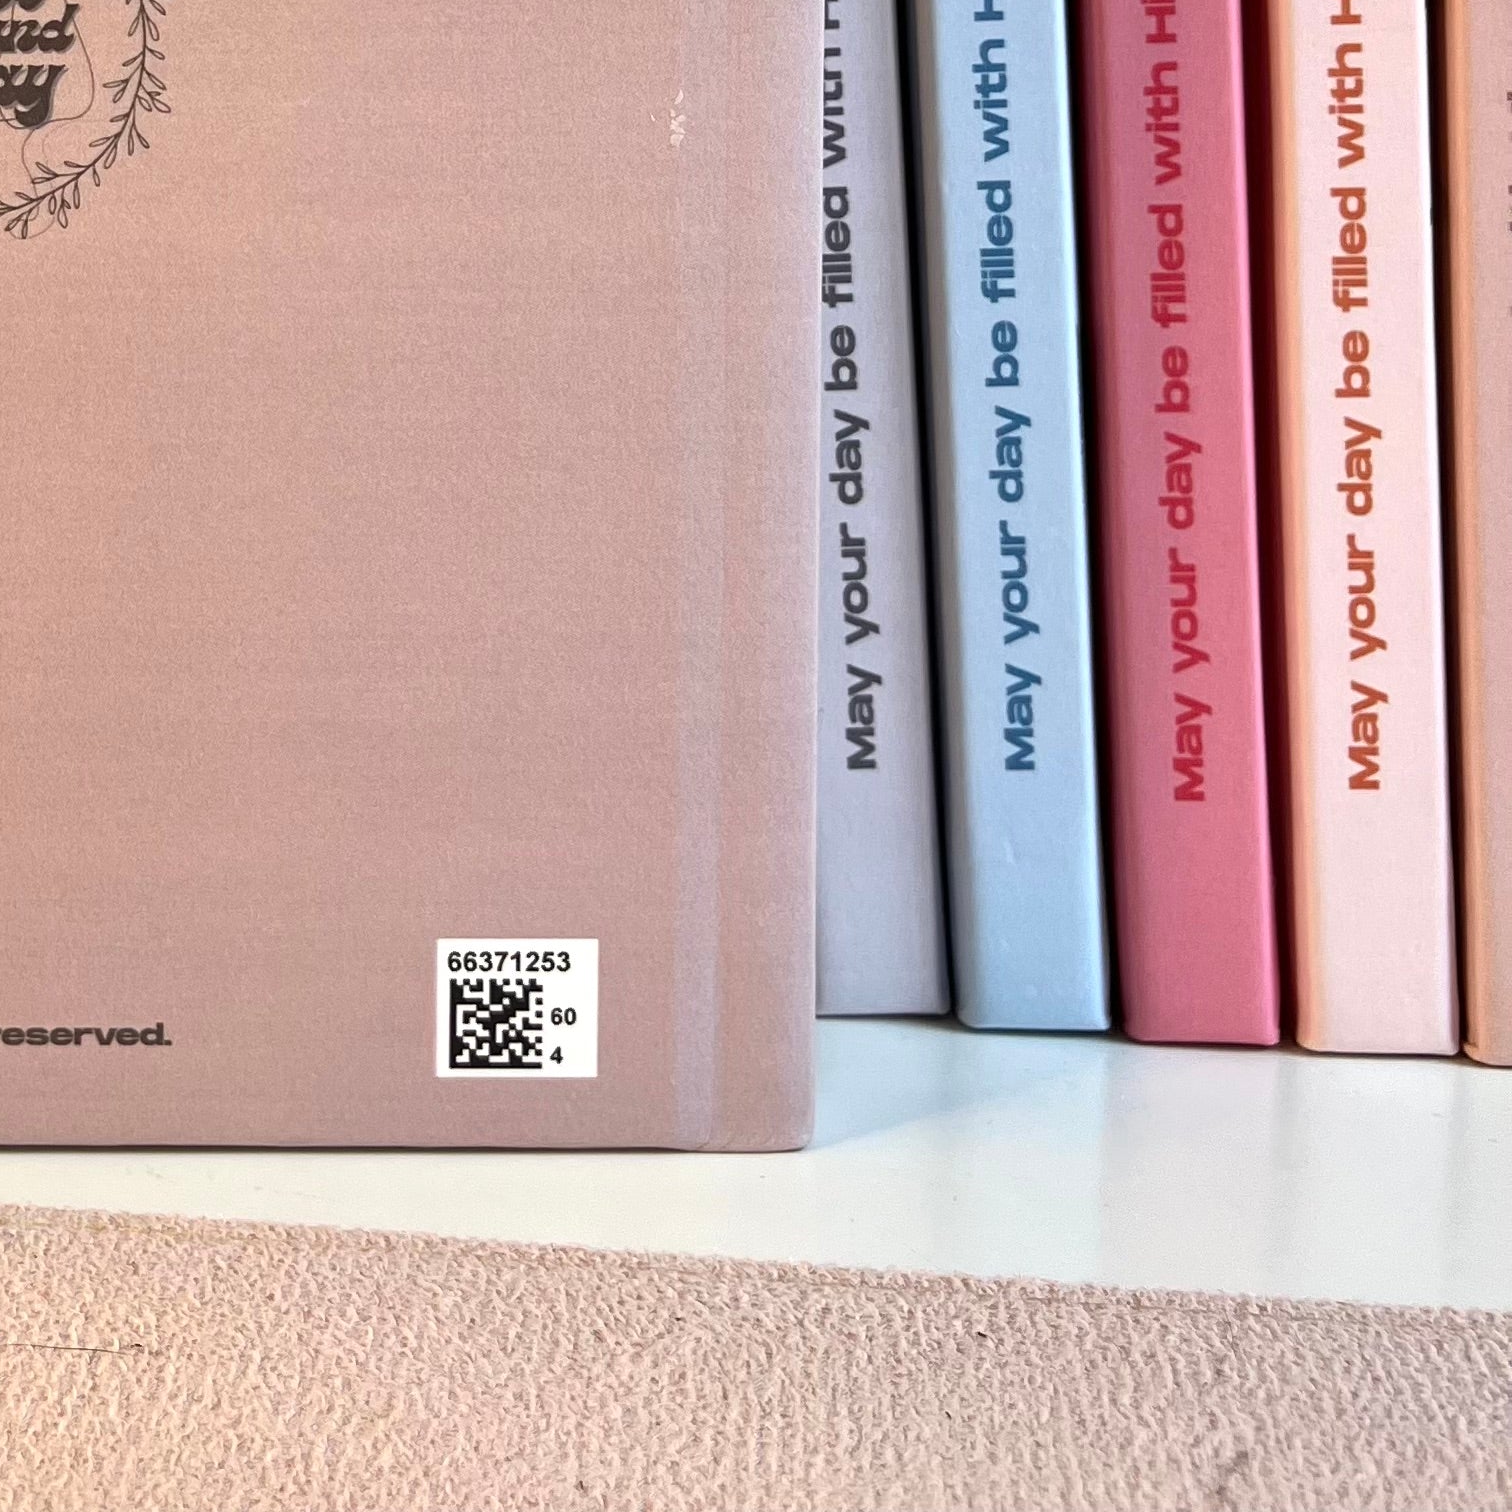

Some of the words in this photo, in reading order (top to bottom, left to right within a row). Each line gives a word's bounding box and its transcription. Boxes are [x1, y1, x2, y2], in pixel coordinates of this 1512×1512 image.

[973, 39, 1009, 162] with
[1144, 62, 1181, 185] with
[1328, 43, 1364, 168] with
[822, 187, 853, 308] filled
[977, 181, 1015, 303] filled
[1148, 204, 1187, 328] filled
[1331, 188, 1368, 312] filled
[825, 326, 858, 391] be
[986, 321, 1019, 387] be
[1155, 347, 1190, 413] be
[1335, 331, 1370, 398] be
[829, 410, 870, 505] day
[989, 406, 1031, 502] day
[1159, 432, 1201, 529] day
[1337, 417, 1381, 516] day
[840, 523, 880, 645] your
[1000, 520, 1040, 644] your
[1169, 548, 1210, 673] your
[1347, 534, 1387, 660] your
[846, 665, 882, 769] May
[1004, 664, 1042, 770] May
[1173, 694, 1212, 801] May
[1349, 681, 1388, 790] May
[448, 951, 571, 972] 66371253
[550, 1046, 564, 1064] 4
[551, 1007, 577, 1026] 60
